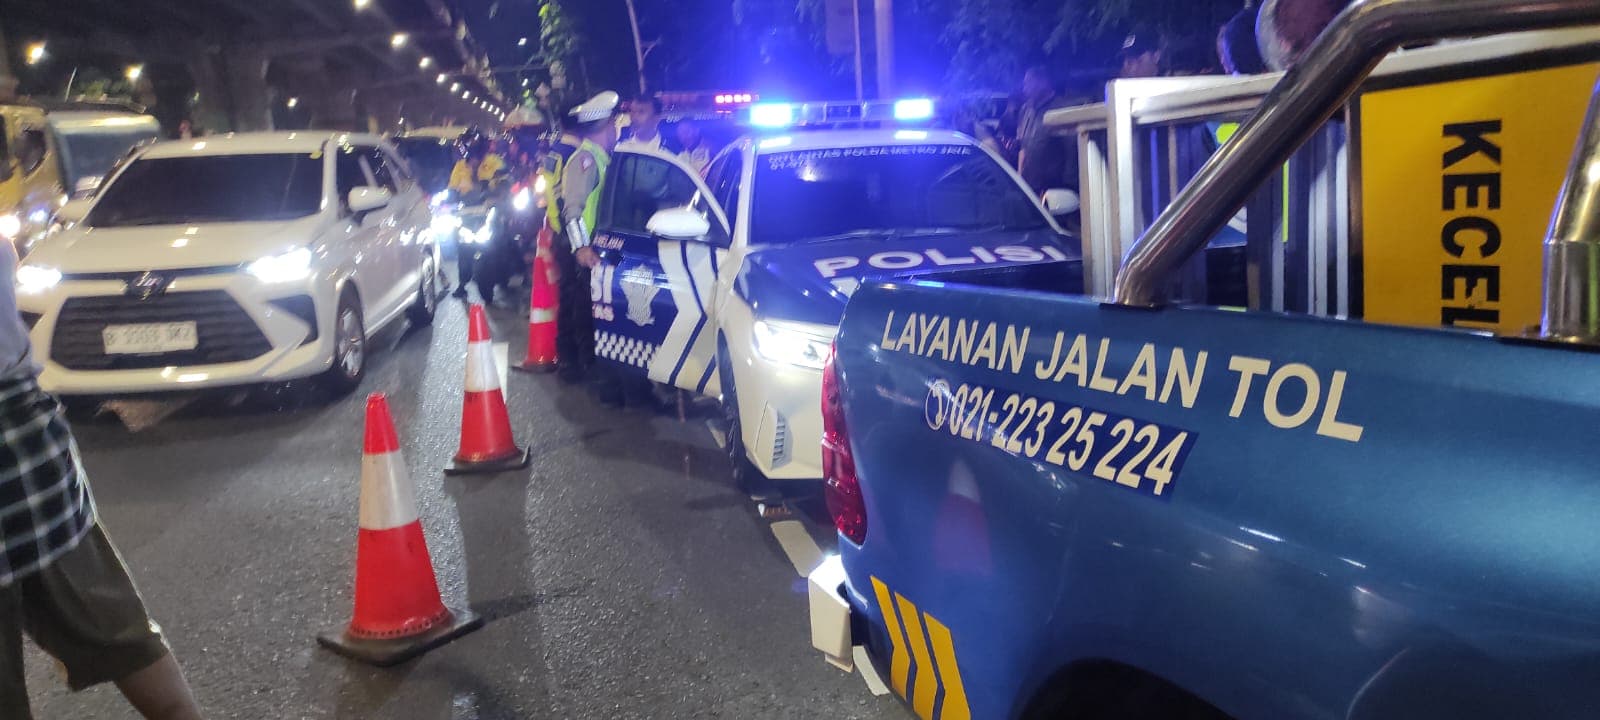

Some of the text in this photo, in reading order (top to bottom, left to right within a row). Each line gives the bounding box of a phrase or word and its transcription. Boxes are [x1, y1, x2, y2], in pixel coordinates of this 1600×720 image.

[813, 245, 1067, 278] POLISI
[881, 310, 1364, 442] LAYANAN JALAN TOL
[949, 384, 1189, 496] 021-223 25 224
